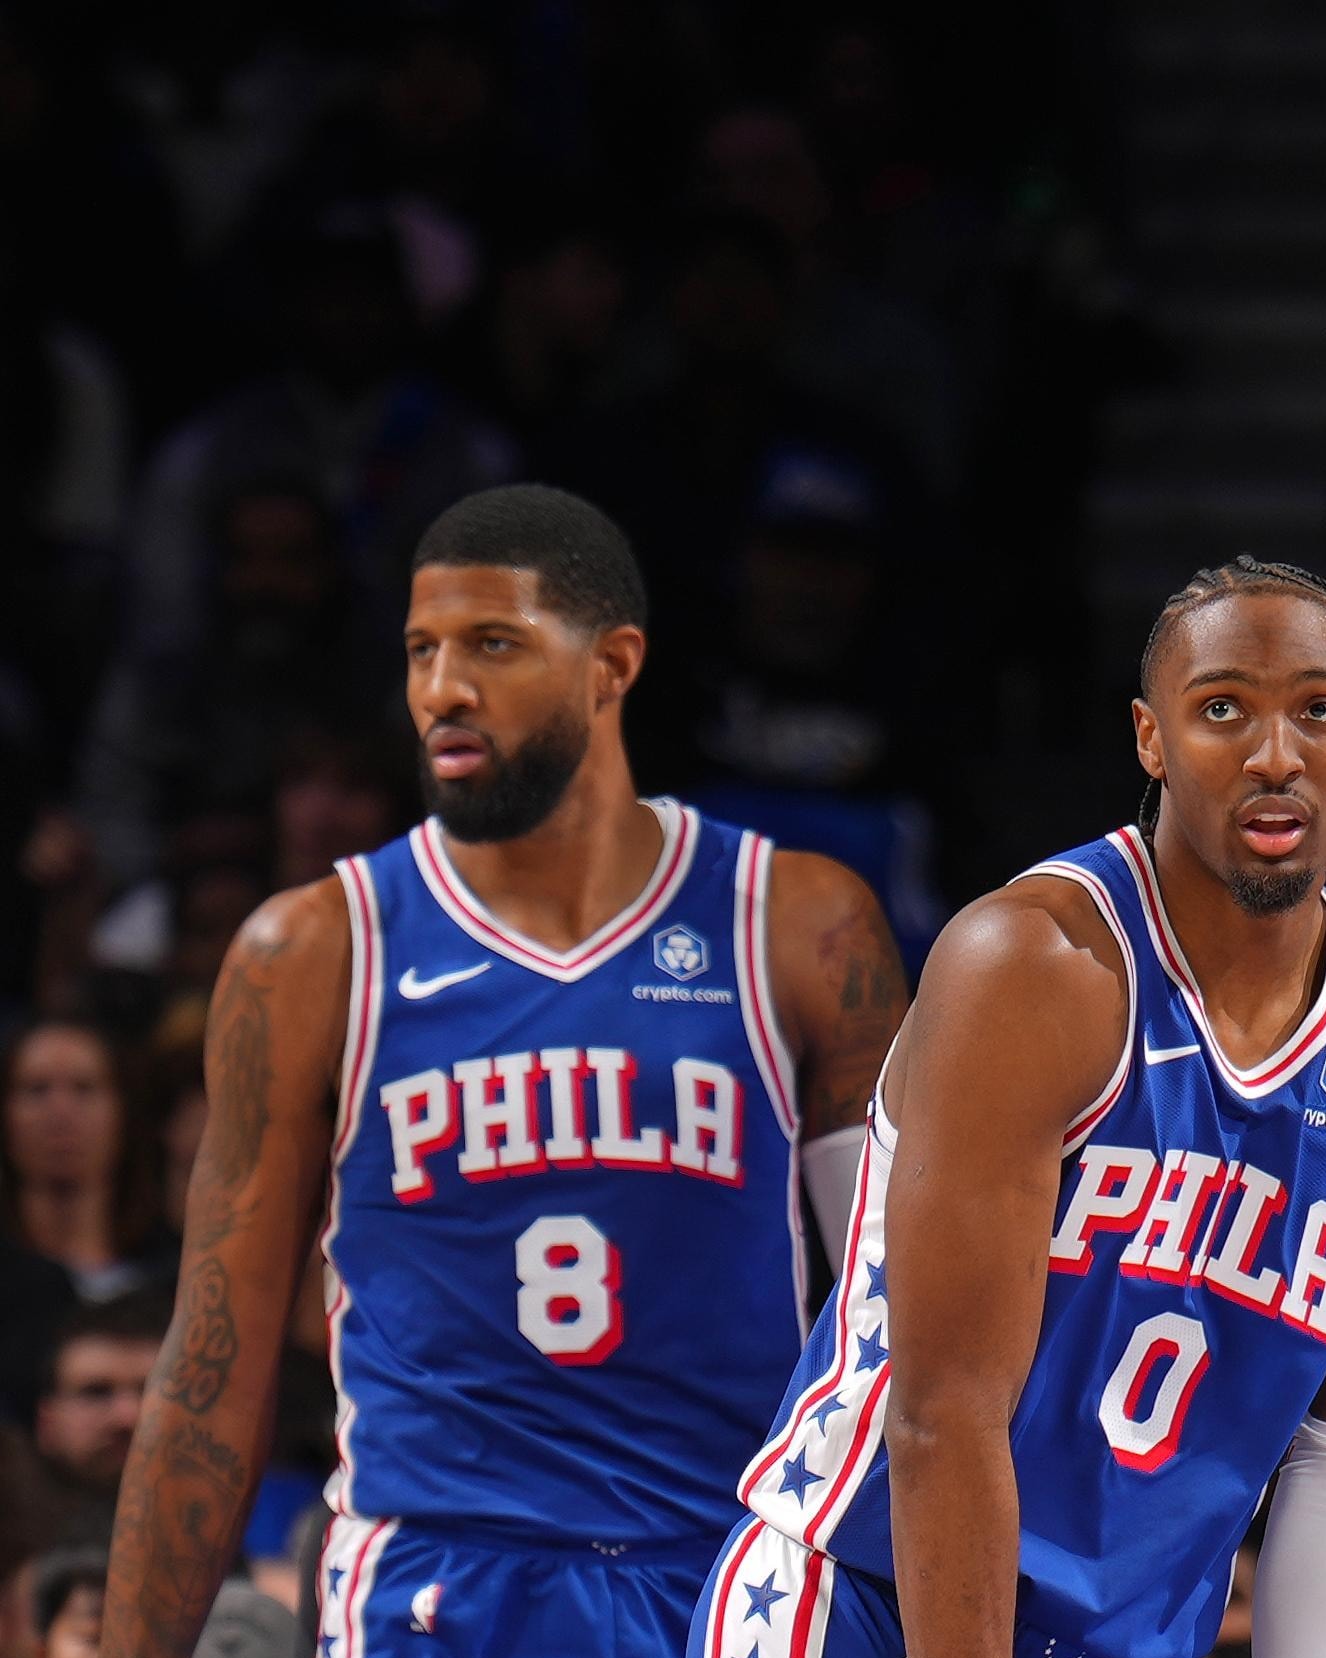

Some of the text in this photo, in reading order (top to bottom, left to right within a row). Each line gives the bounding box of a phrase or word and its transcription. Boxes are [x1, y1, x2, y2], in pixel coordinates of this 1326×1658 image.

[632, 985, 733, 1004] crypto.com
[380, 1047, 744, 1204] PHILA
[515, 1215, 623, 1366] 8
[1099, 1311, 1211, 1473] 0
